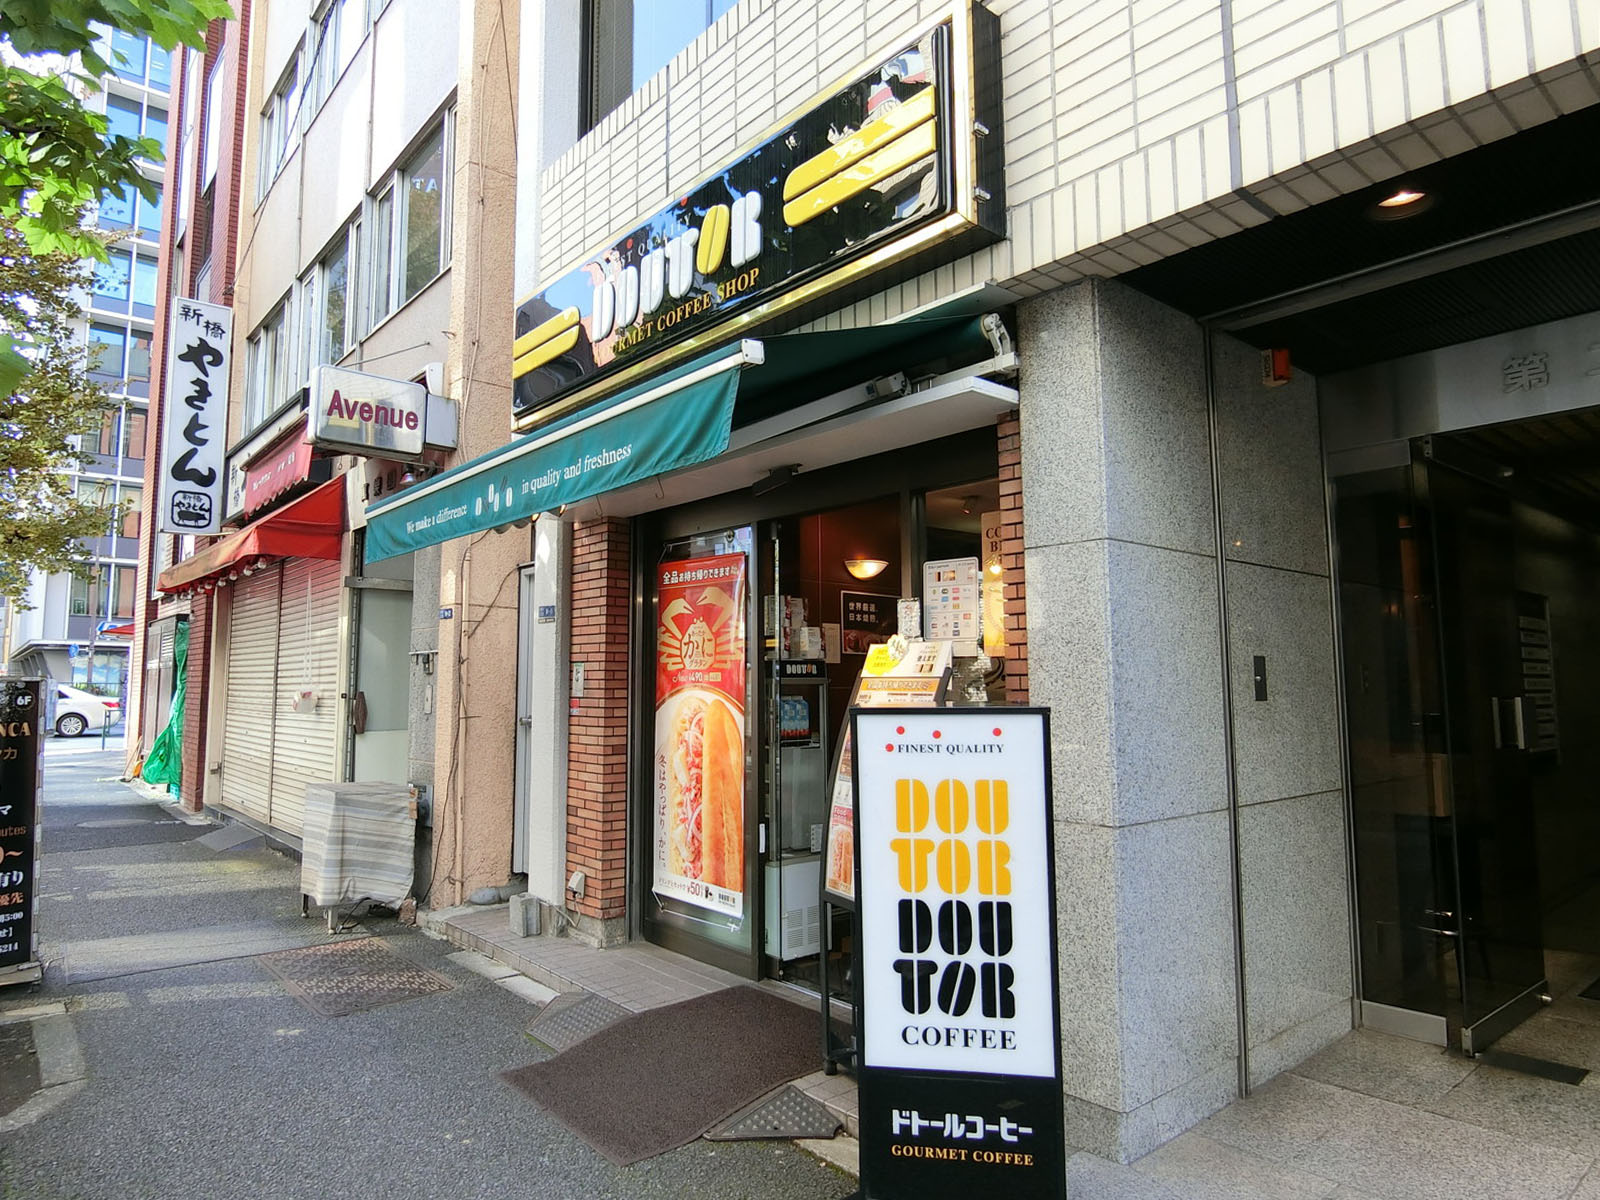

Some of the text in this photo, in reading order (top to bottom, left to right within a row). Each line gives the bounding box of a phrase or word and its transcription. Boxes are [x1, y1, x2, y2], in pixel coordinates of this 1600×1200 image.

[592, 191, 761, 342] DOUTOR
[657, 291, 712, 331] COFFEE
[717, 267, 759, 302] SHOP
[179, 304, 226, 340] 新橋
[171, 336, 224, 487] やきとん
[327, 389, 419, 430] Avenue
[521, 443, 632, 495] in quality and freshness
[173, 501, 210, 513] やきとん
[406, 520, 415, 534] We
[415, 515, 431, 531] make
[436, 504, 467, 524] difference
[683, 633, 713, 659] かに
[16, 695, 32, 706] 6F
[898, 744, 1004, 755] FINEST QUALITY
[901, 1025, 1017, 1050] COFFEE
[892, 1109, 1033, 1142] ドトールコーヒー
[891, 1144, 1034, 1166] GOURMET COFFEE
